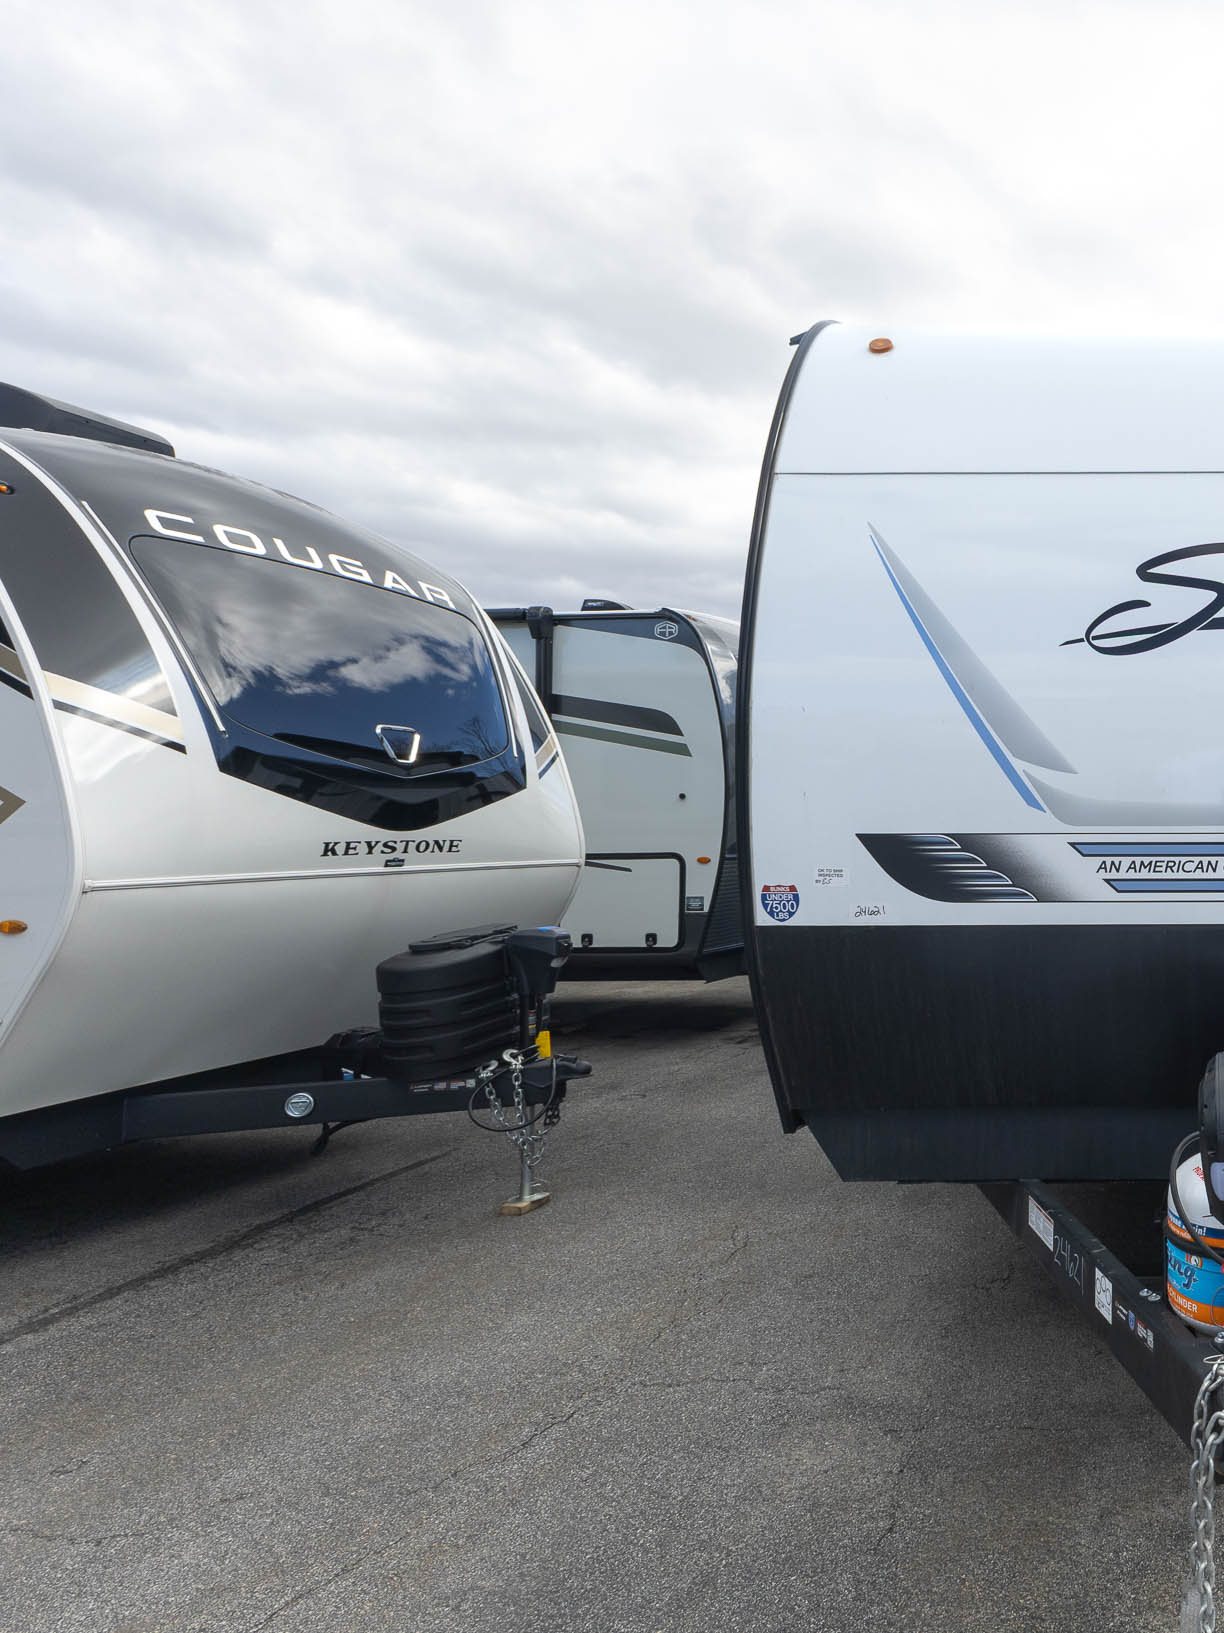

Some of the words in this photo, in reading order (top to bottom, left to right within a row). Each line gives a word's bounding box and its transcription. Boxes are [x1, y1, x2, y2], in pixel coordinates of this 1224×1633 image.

[143, 508, 457, 610] COUGAR
[320, 839, 463, 857] KEYSTONE
[1096, 860, 1122, 873] AN
[1126, 860, 1219, 873] AMERICAN
[764, 900, 797, 913] 7500
[854, 905, 886, 918] 24621
[773, 912, 790, 920] LBS
